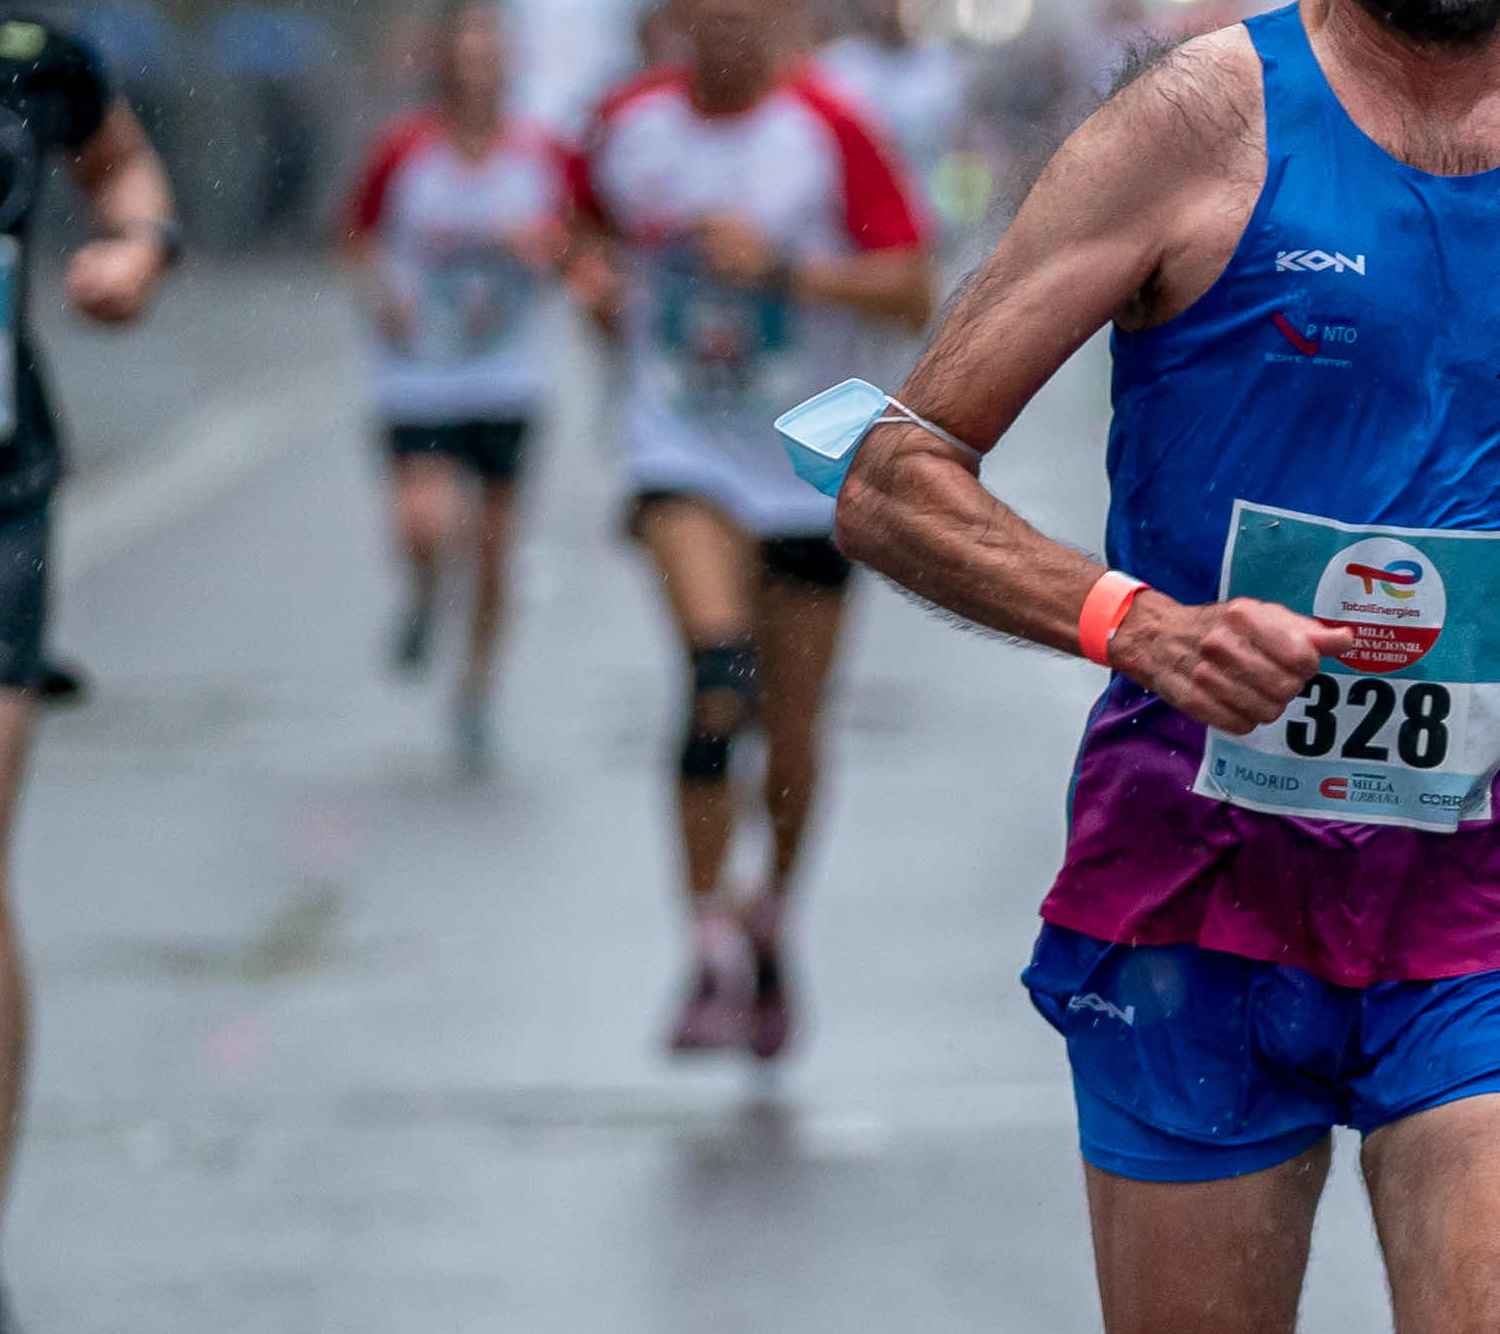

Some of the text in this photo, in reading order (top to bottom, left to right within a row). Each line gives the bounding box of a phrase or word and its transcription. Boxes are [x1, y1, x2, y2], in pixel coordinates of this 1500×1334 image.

[1340, 601, 1421, 619] TotalEnergies
[1356, 626, 1396, 640] MILLA
[1351, 638, 1424, 653] RNACIONAL
[1360, 651, 1408, 664] MADRID
[1285, 673, 1451, 769] 328
[1235, 765, 1299, 791] MADRID
[1350, 779, 1395, 793] MILLA
[1419, 793, 1467, 806] CORR
